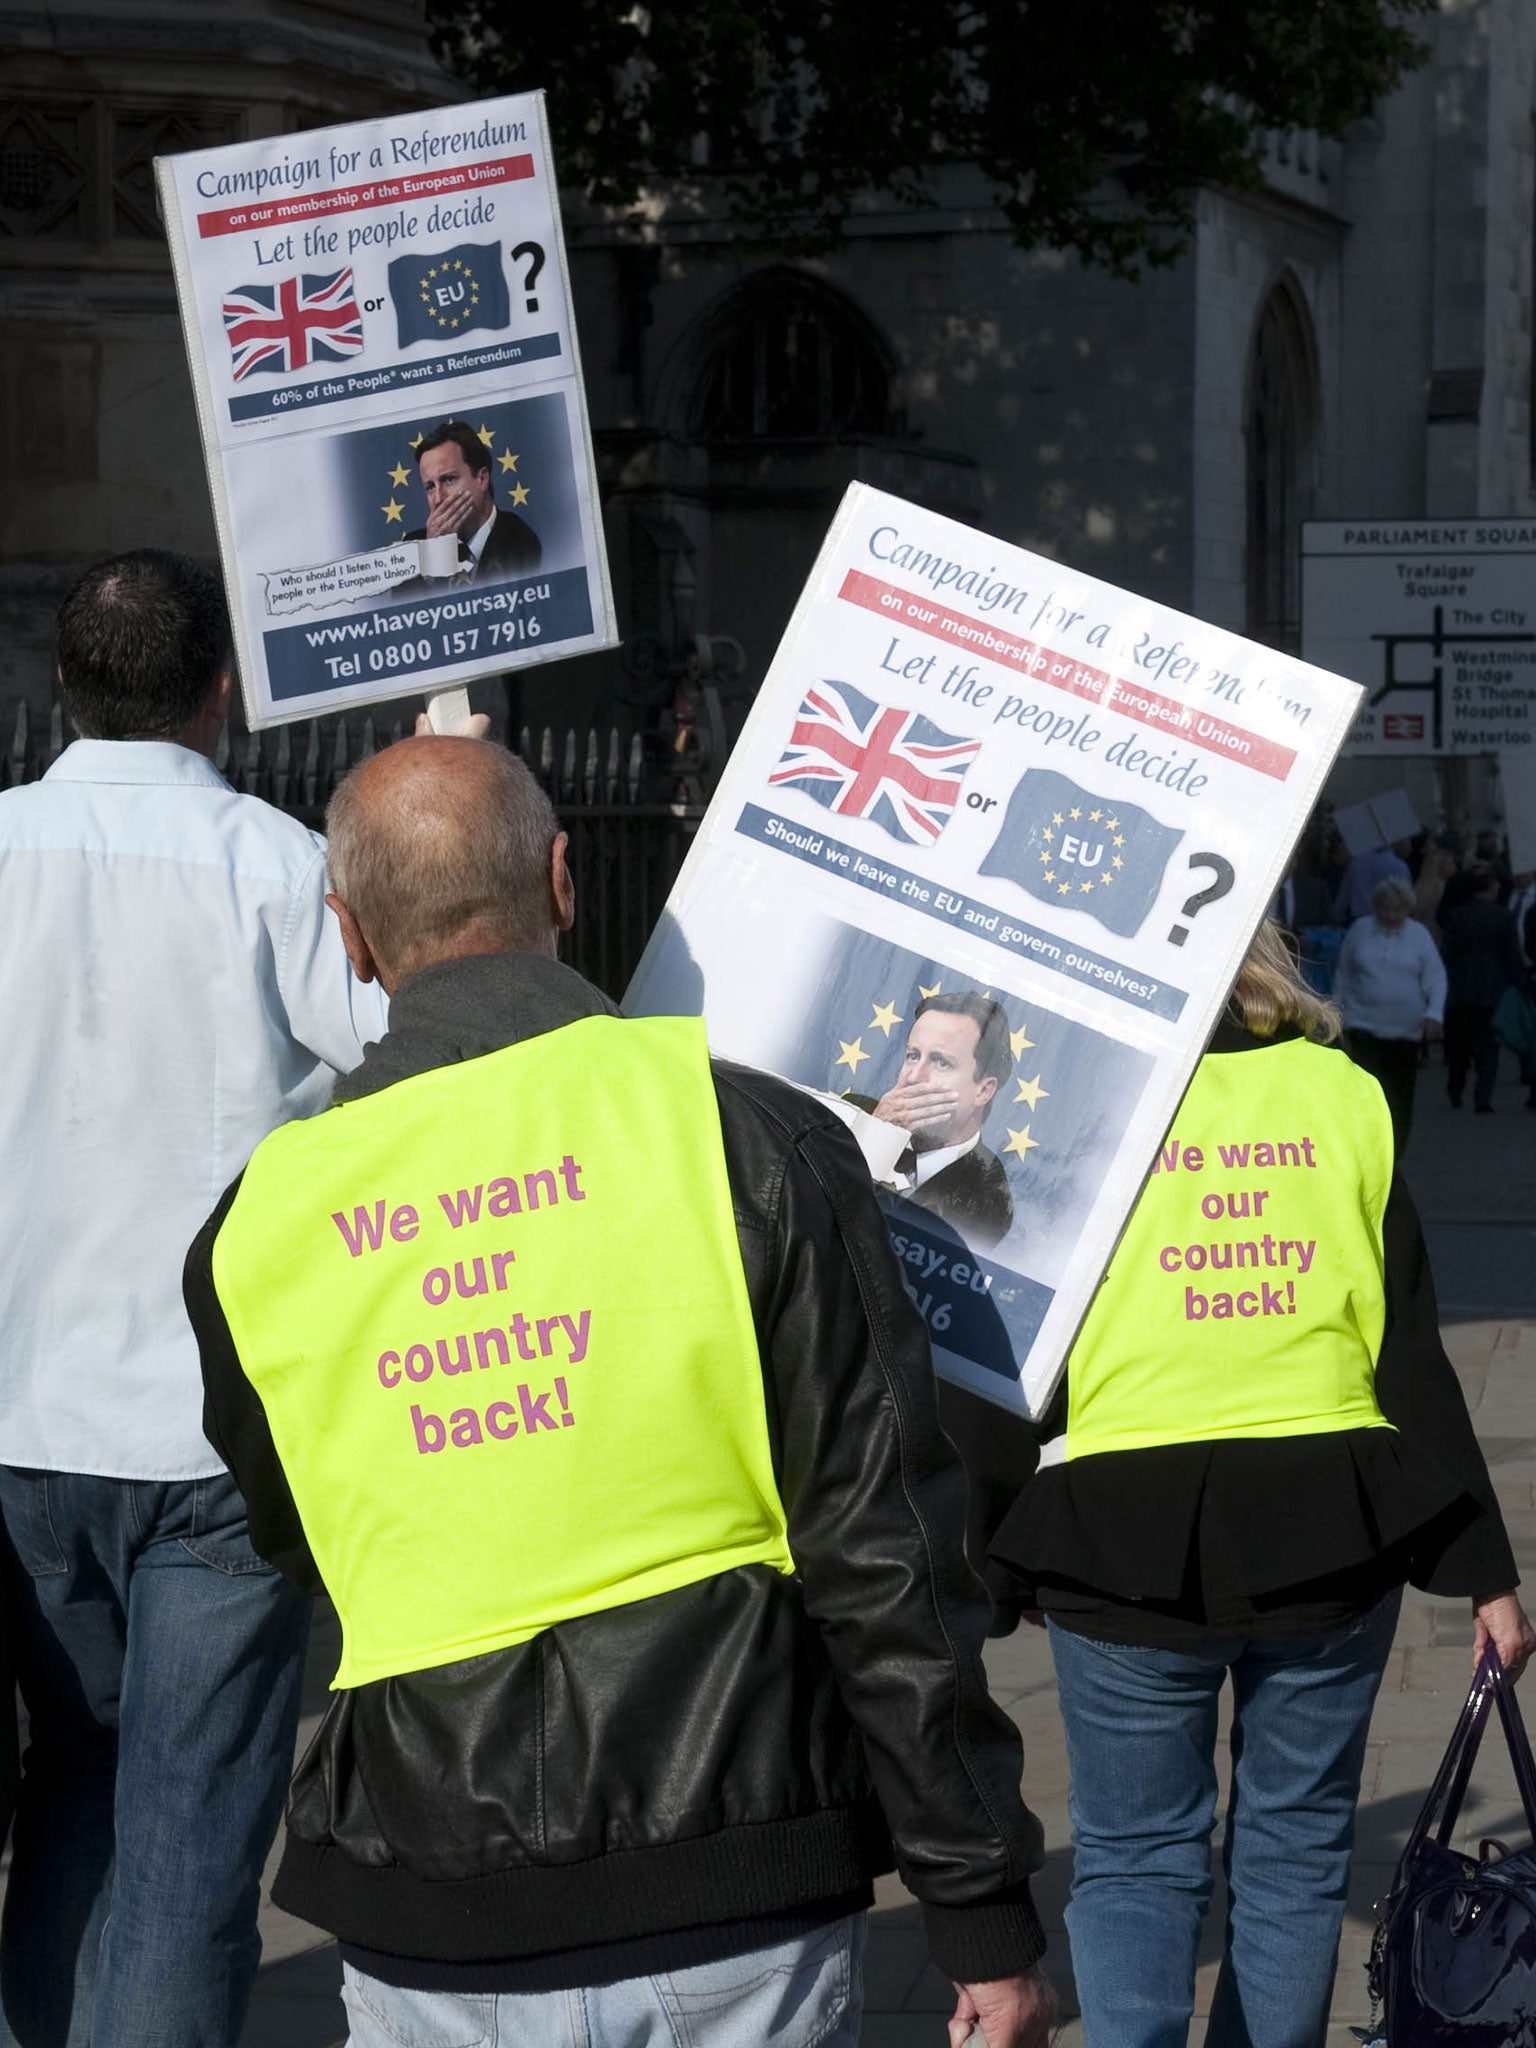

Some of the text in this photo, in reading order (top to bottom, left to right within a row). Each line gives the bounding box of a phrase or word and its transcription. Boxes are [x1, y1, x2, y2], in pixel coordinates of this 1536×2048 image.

[196, 118, 528, 198] Campaign for a Referendum
[229, 164, 506, 226] on our membership of the European Union
[253, 198, 496, 266] Let the people decide
[363, 241, 546, 316] or EU ?
[272, 390, 303, 406] 60%
[306, 384, 320, 400] of
[322, 382, 344, 398] the
[401, 364, 433, 380] want
[436, 363, 444, 374] a
[447, 348, 522, 371] Referendum
[1344, 529, 1468, 544] PARLIAMENT
[272, 564, 416, 604] people or the European Union?
[280, 554, 406, 586] Who should I listen to, the
[868, 526, 1028, 614] Campaign
[1030, 590, 1085, 633] for
[1086, 624, 1112, 648] a
[1396, 564, 1476, 580] Trafalgar
[1404, 582, 1467, 598] Square
[305, 583, 551, 648] www.haveyoursay.eu
[1453, 610, 1527, 626] The City
[325, 616, 542, 680] Tel 0800 157 7916
[880, 593, 1251, 755] on our membership of the European Union
[1456, 668, 1514, 685] Bridge
[880, 638, 1209, 797] Let the people decide
[1452, 686, 1471, 701] St
[1455, 704, 1528, 720] Hospital
[1452, 730, 1532, 744] Waterloo
[966, 790, 1236, 948] or EU ?
[764, 818, 1158, 1000] Should we leave the EU and govern ourselves?
[1152, 1137, 1317, 1174] We want
[331, 1155, 586, 1258] We want
[1201, 1190, 1270, 1220] our
[422, 1250, 516, 1306] our
[1159, 1234, 1316, 1274] country
[1185, 1280, 1296, 1320] back!
[378, 1309, 591, 1388] country
[410, 1376, 575, 1454] back!
